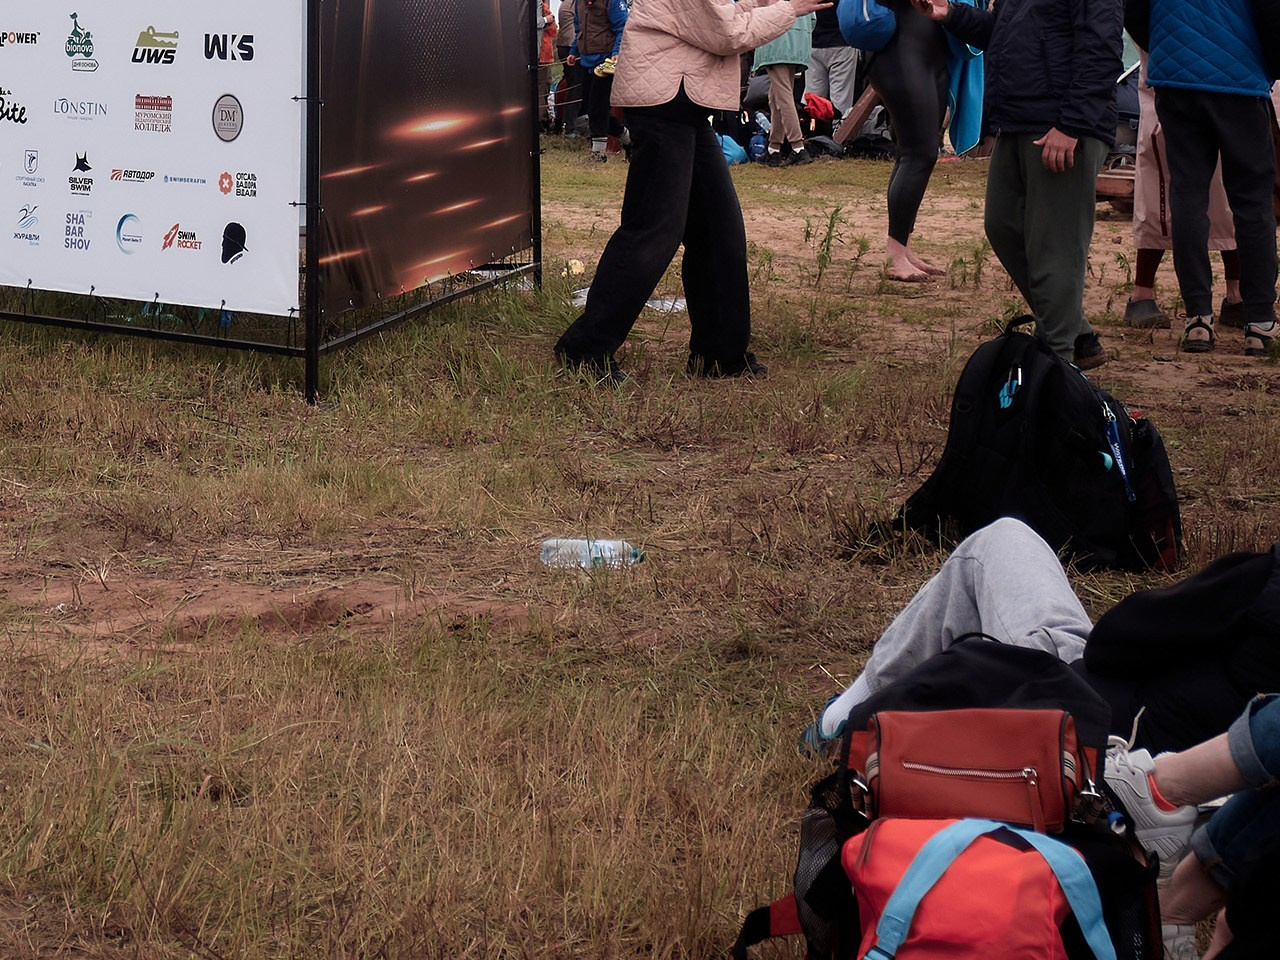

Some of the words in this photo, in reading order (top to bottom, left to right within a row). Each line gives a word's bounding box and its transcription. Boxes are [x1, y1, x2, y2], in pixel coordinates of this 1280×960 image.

[65, 42, 94, 53] bionova
[131, 47, 176, 64] UWS
[220, 109, 236, 122] DM
[134, 122, 172, 133] КОЛЛЕДЖ
[68, 177, 93, 185] SILVER
[169, 176, 207, 184] SWIMSERAFIM
[70, 184, 91, 192] SWIM
[66, 213, 85, 225] SHA
[13, 232, 40, 241] ЖУРАВЛИ
[65, 225, 84, 237] BAR
[177, 230, 197, 241] SWIM
[64, 237, 91, 250] SHOV
[177, 239, 202, 250] ROCKET
